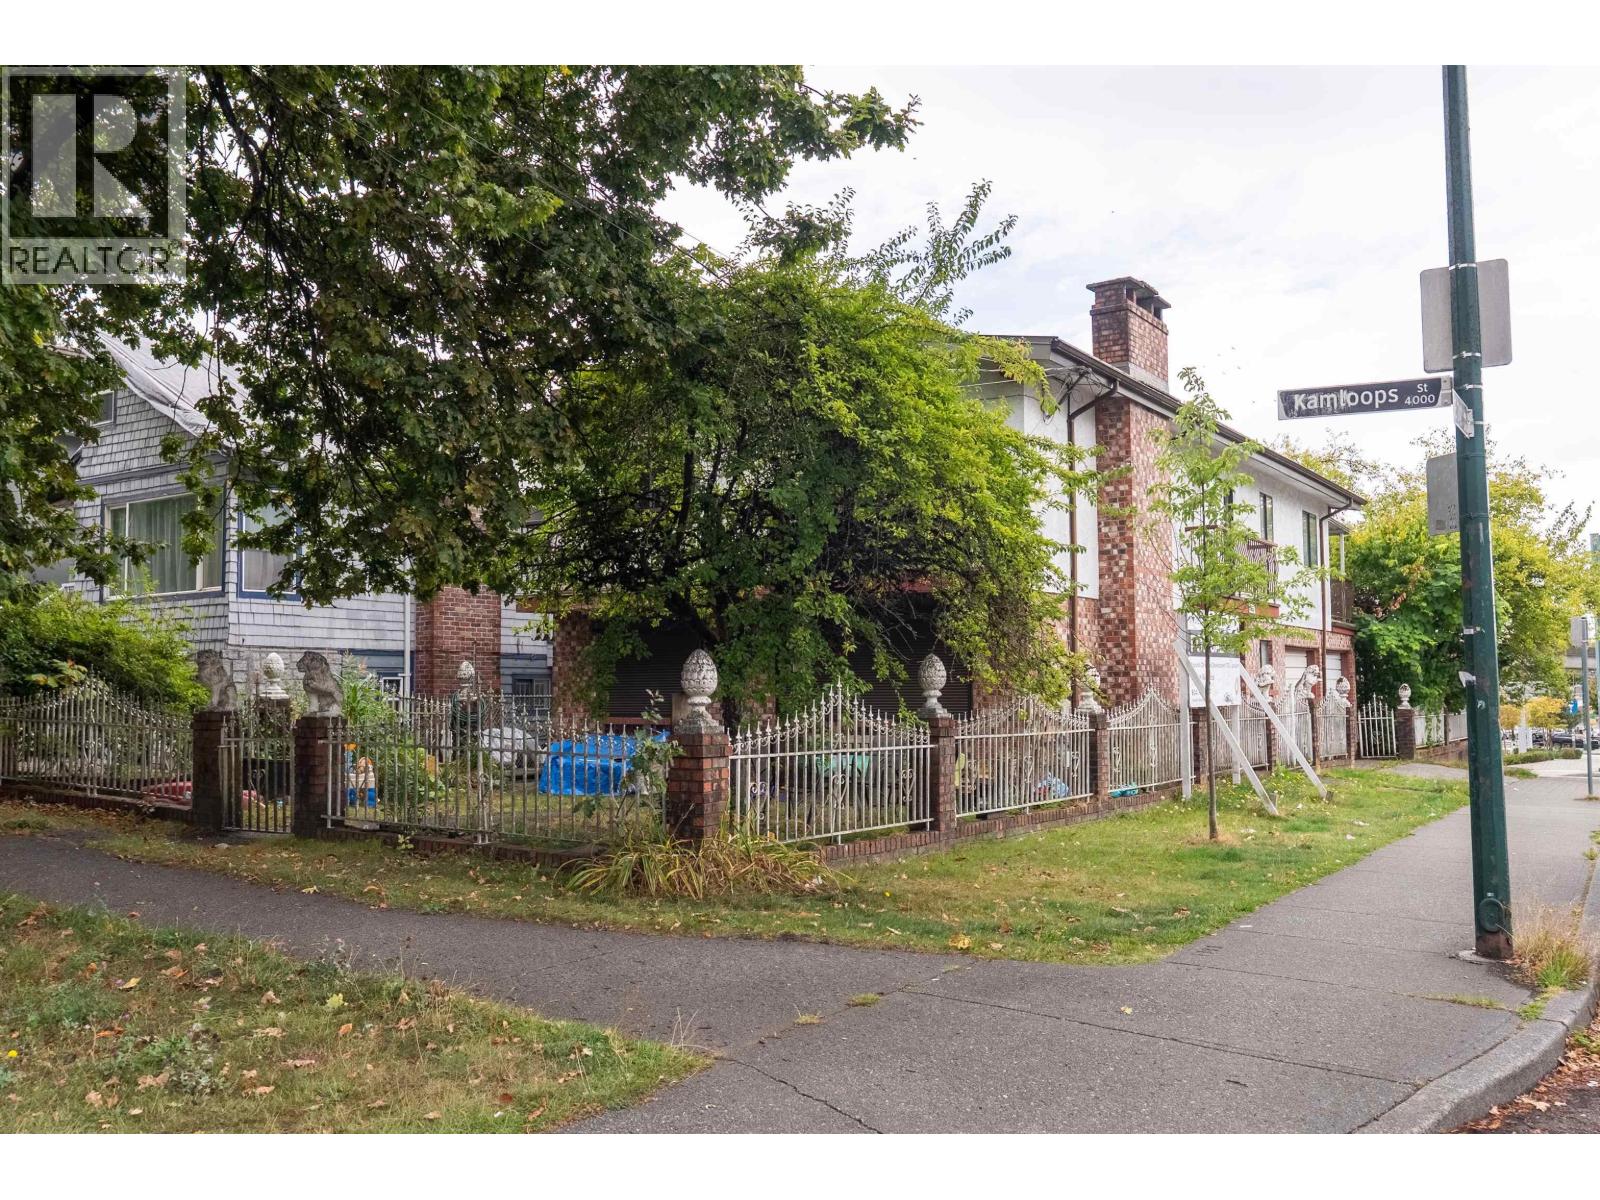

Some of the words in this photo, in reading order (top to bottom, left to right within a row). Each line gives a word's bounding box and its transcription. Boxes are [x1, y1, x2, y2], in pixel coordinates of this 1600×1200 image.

[1416, 382, 1429, 393] St
[1294, 388, 1399, 411] Kamloops
[1404, 394, 1436, 406] 4000
